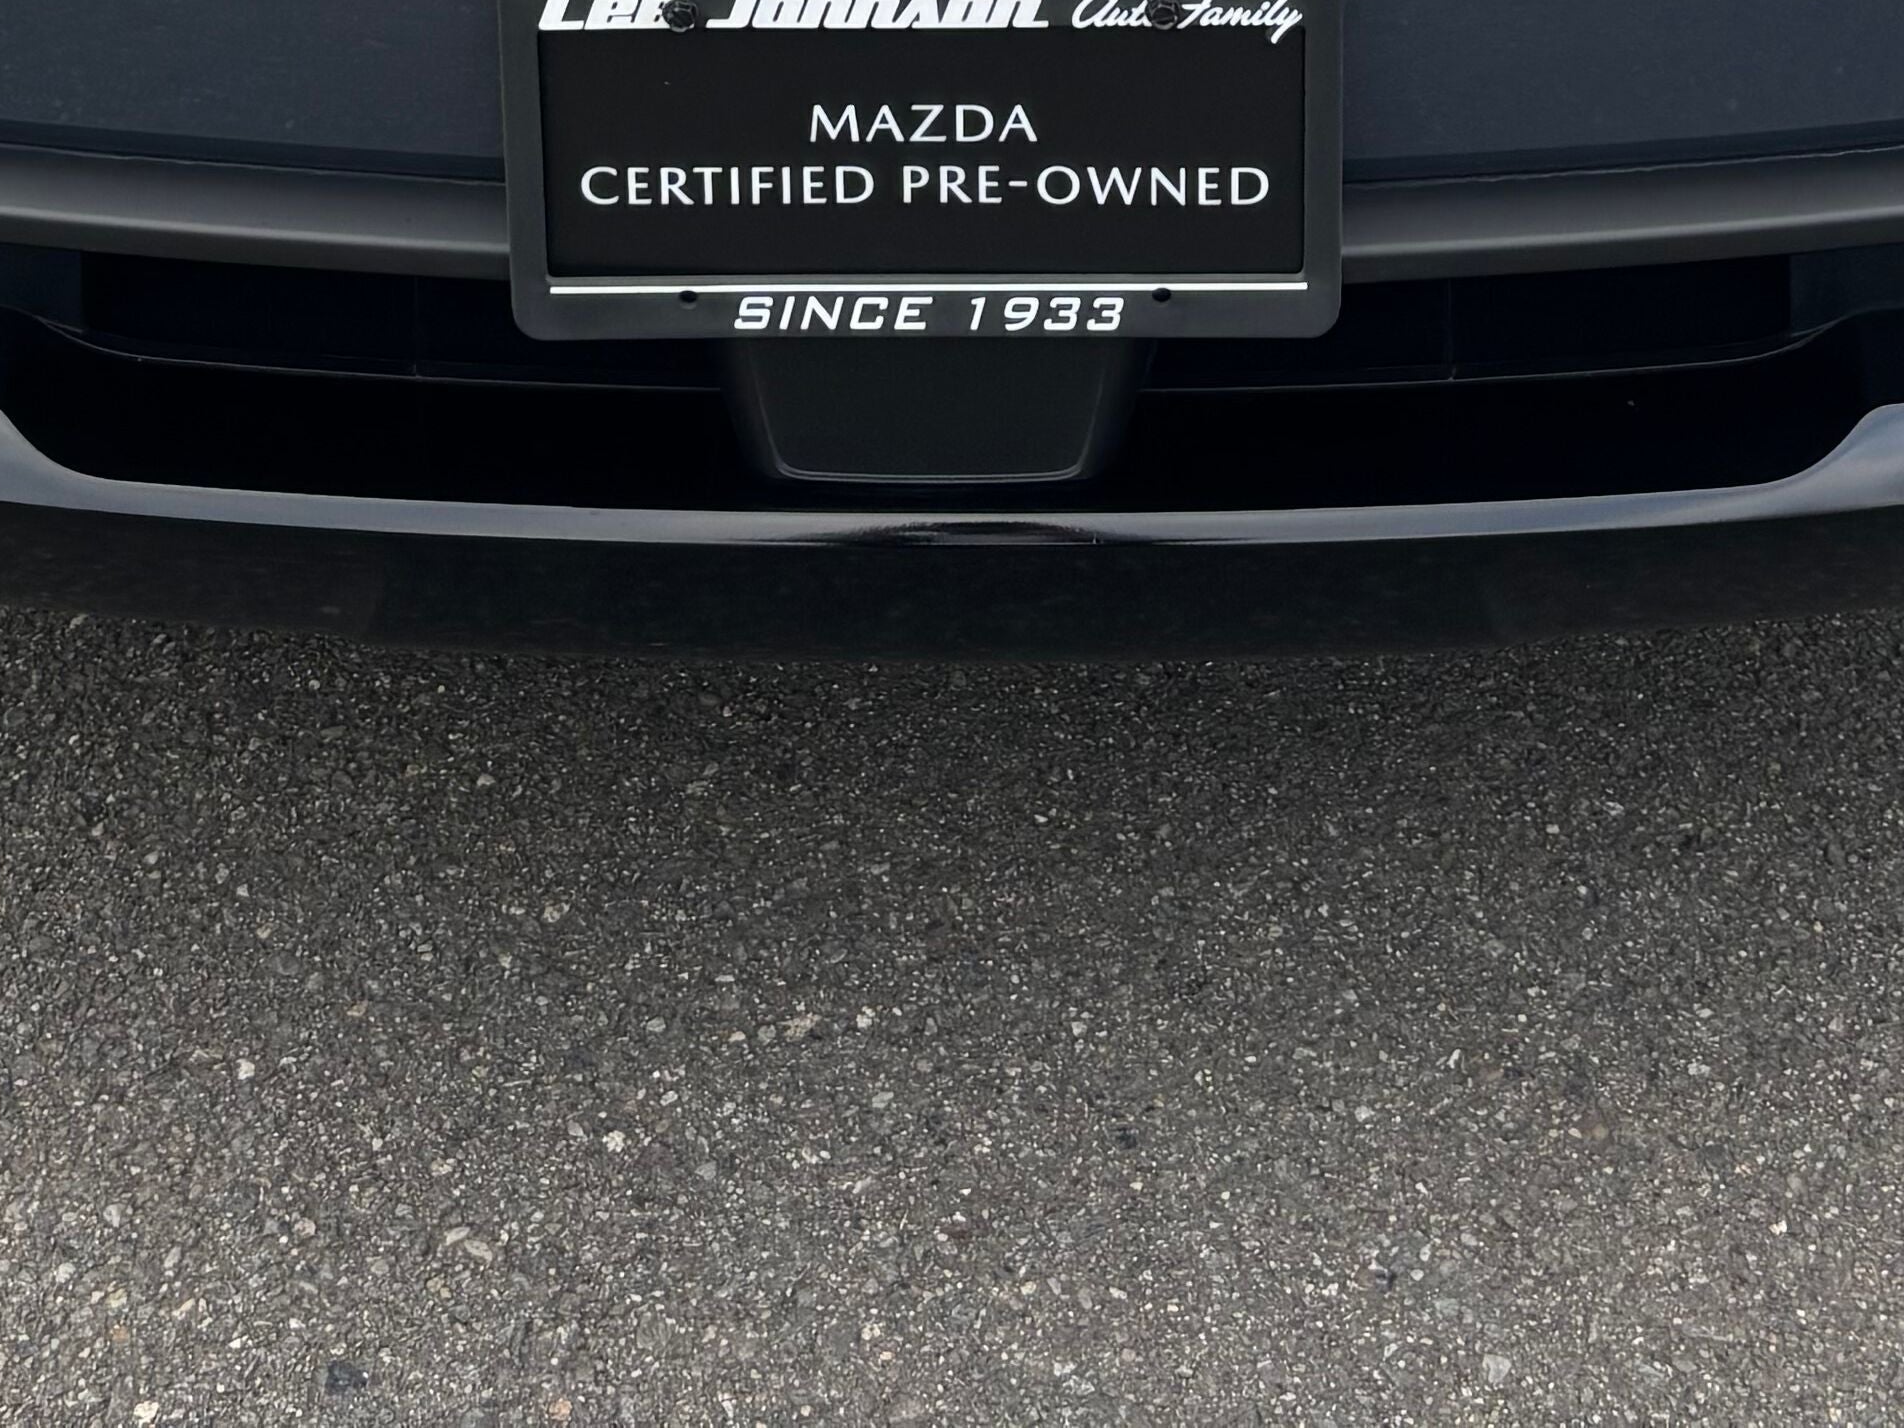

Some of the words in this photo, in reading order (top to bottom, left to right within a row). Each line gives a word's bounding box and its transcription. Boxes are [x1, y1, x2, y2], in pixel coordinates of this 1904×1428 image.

[809, 104, 1038, 142] MAZDA
[580, 165, 874, 205] CERTIFIED
[902, 165, 1270, 206] PRE-OWNED
[733, 295, 934, 331] SINCE
[969, 295, 1125, 331] 1933
